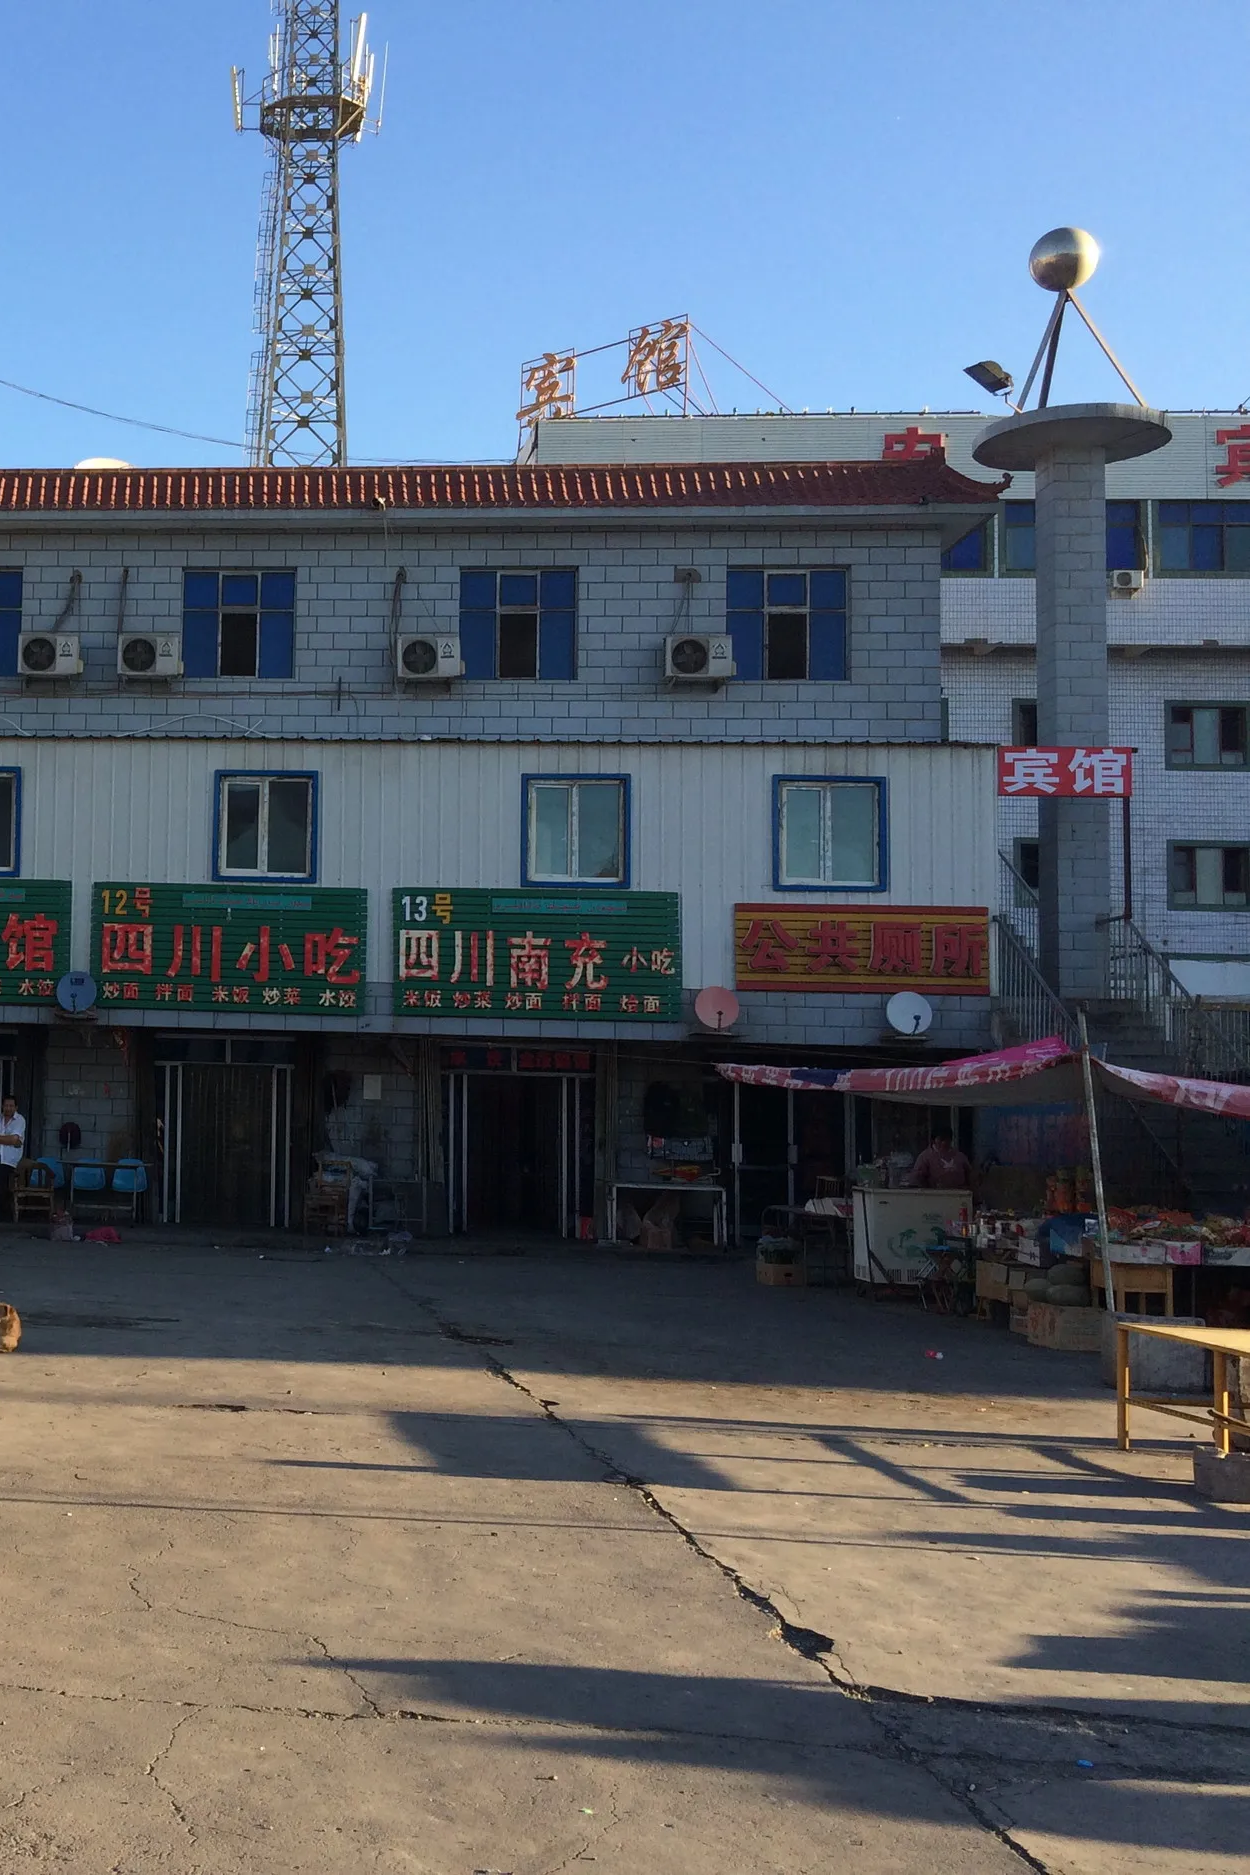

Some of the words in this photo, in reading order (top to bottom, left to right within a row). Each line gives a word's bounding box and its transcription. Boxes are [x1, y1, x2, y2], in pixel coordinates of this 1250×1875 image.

[1002, 748, 1128, 795] 宾馆
[101, 887, 153, 919] 12号
[401, 893, 454, 925] 13号
[101, 922, 361, 985] 四川小吃
[399, 930, 610, 991] 四川南充
[621, 946, 676, 976] 小吃
[739, 918, 988, 978] 公共厕所
[101, 981, 140, 1001] 炒面
[154, 982, 195, 1003] 拌面
[211, 985, 251, 1005] 米饭
[261, 986, 302, 1007] 炒菜
[402, 989, 443, 1009] 米饭
[452, 989, 493, 1010] 炒菜
[504, 991, 544, 1012] 炒面
